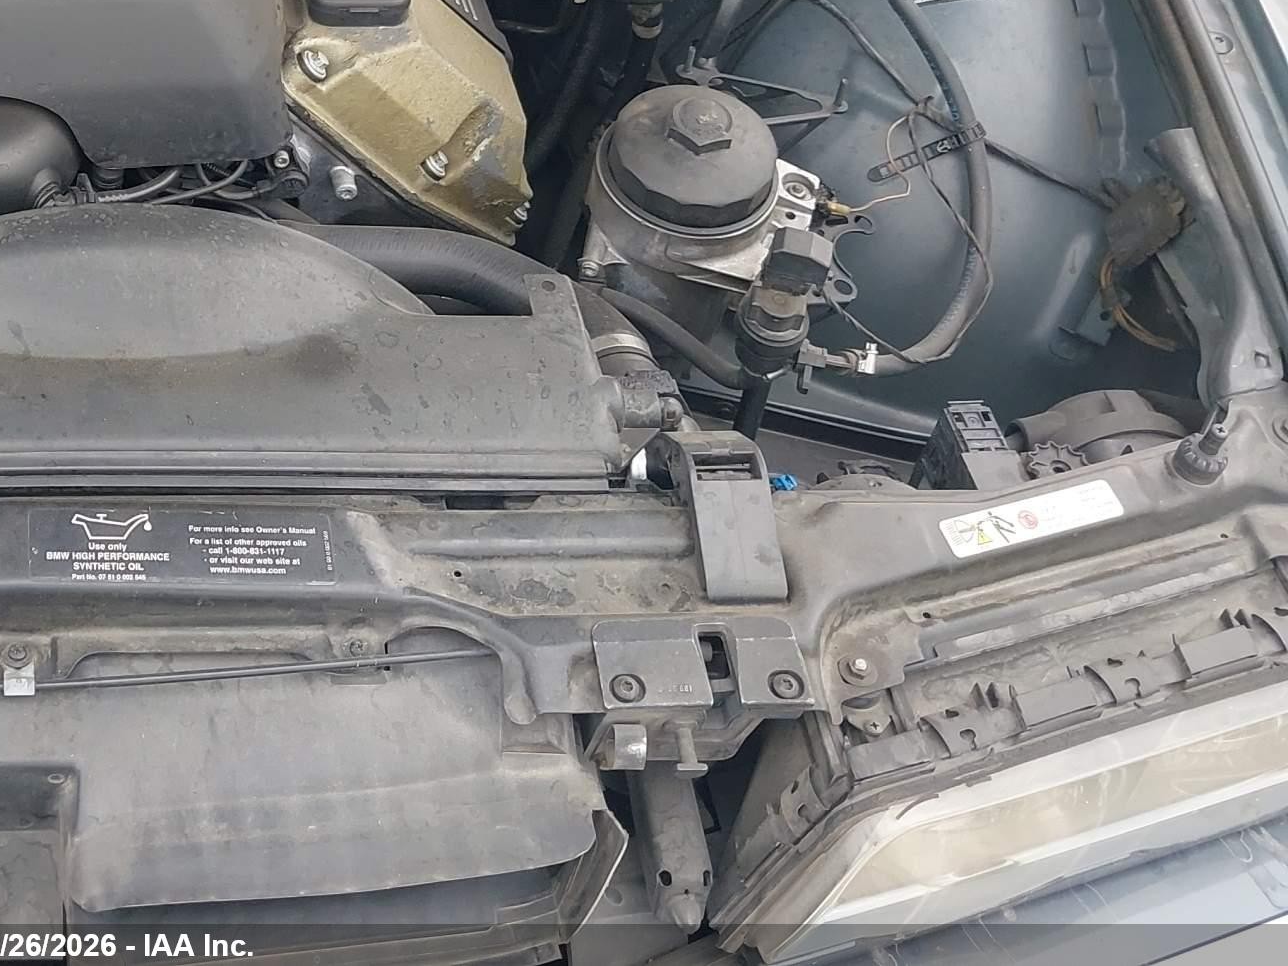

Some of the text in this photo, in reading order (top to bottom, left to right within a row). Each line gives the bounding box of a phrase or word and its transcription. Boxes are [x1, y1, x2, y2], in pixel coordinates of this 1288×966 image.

[88, 542, 128, 552] Use only
[256, 539, 291, 548] approved
[46, 552, 170, 561] BMW HIGH PERFORMANCE
[225, 548, 285, 556] 1-800-831-1117
[73, 562, 144, 571] SYNTHETIC OIL
[210, 566, 286, 574] www.bmwusa.com
